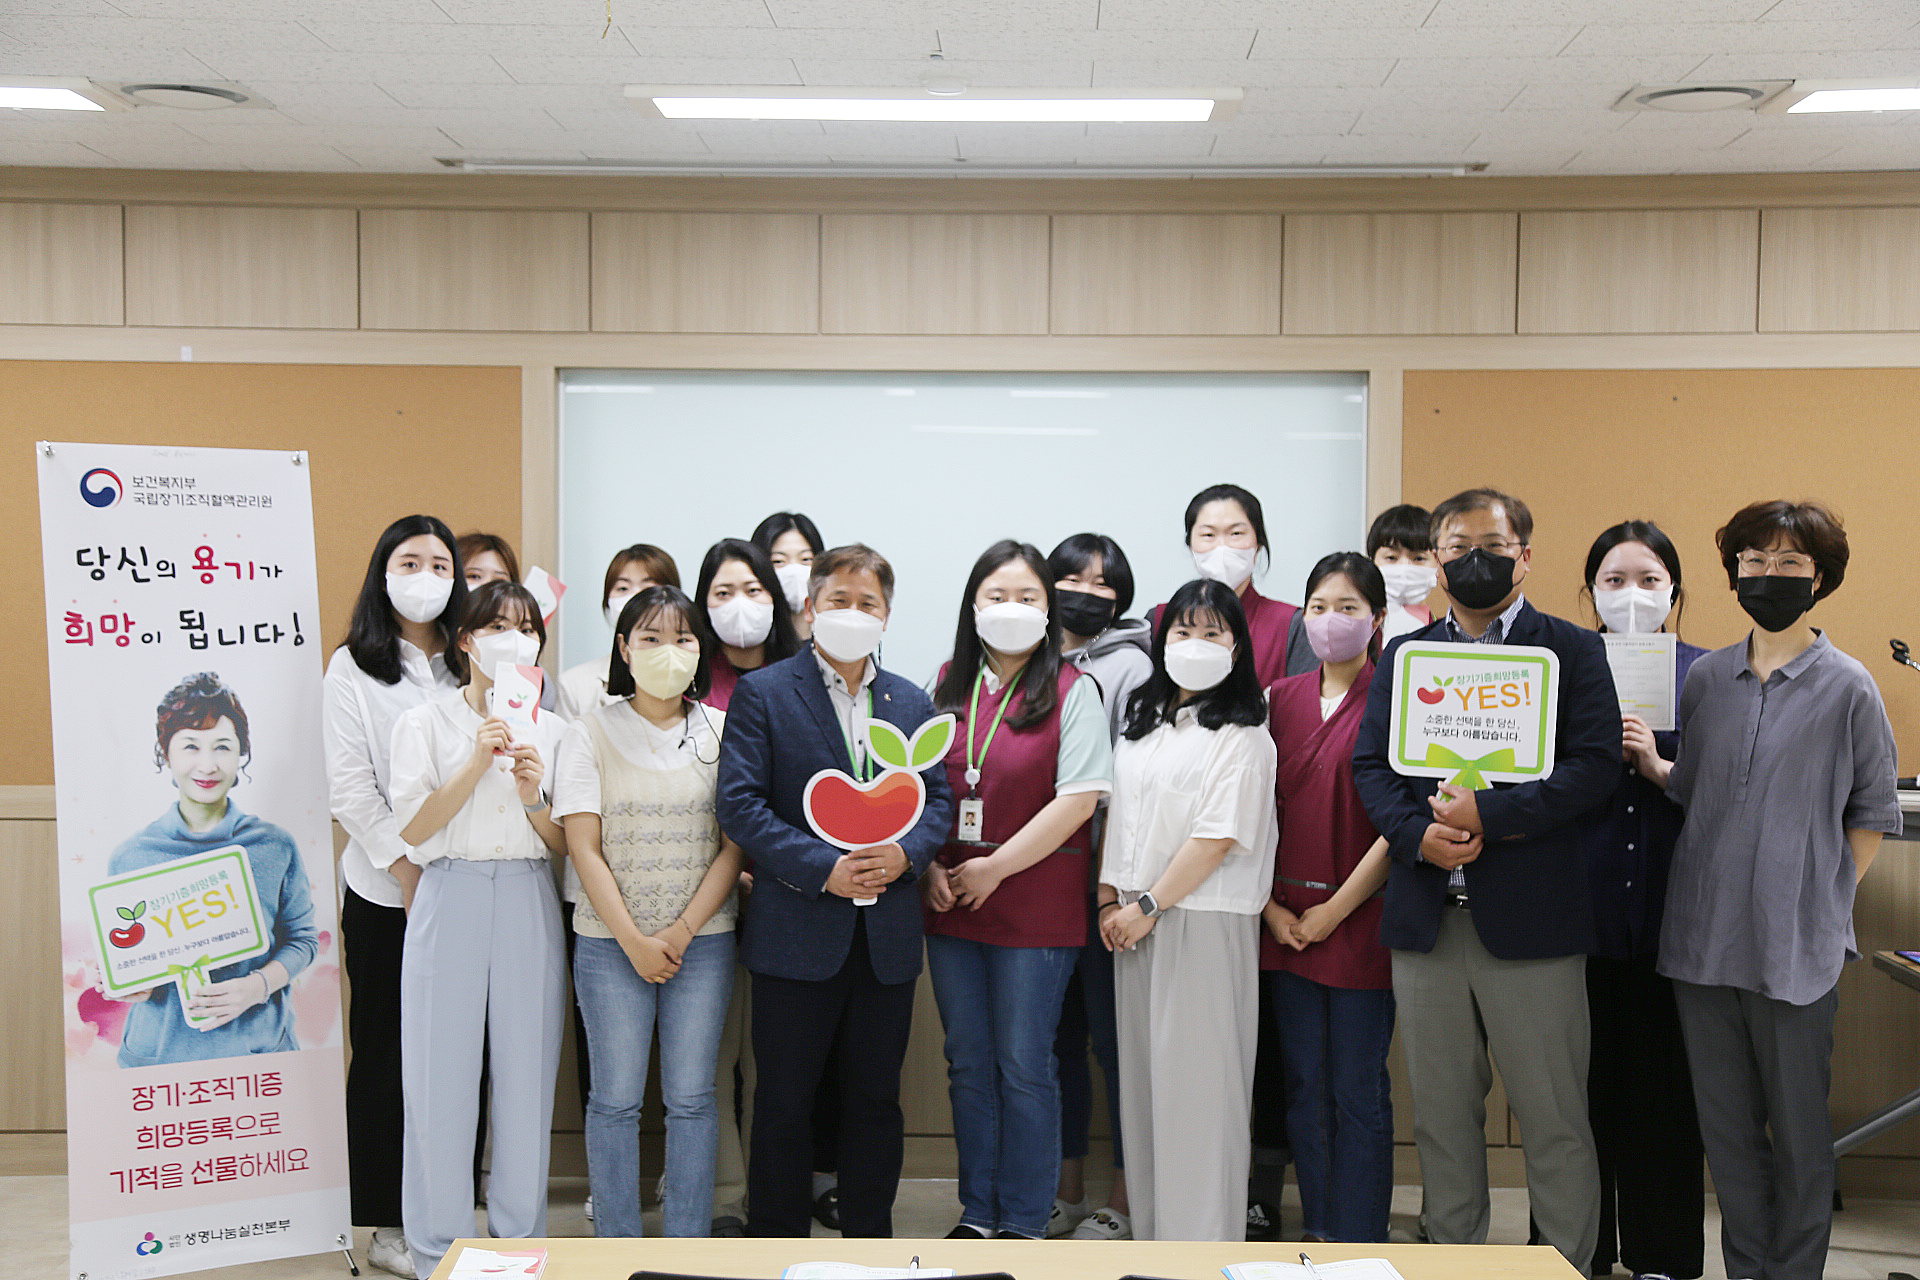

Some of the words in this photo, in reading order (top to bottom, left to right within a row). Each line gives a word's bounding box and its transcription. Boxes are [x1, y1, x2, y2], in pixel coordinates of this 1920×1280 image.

[132, 475, 197, 489] 보건복지부
[133, 491, 273, 508] 국립장기조직혈액관리원
[76, 546, 176, 583] 당신의
[192, 545, 283, 584] 용기가
[63, 611, 161, 647] 희망이
[179, 609, 305, 650] 됩니다!
[1453, 681, 1531, 711] YES!
[1422, 726, 1459, 738] 누구보다
[1425, 714, 1453, 725] 소중한
[1456, 716, 1482, 726] 선택을
[1485, 718, 1495, 728] 한
[150, 883, 239, 938] YES!
[132, 1072, 283, 1111] 장기·조직기증
[136, 1111, 282, 1150] 희망등록으로
[110, 1162, 184, 1194] 기적을
[191, 1148, 310, 1185] 선물하세요
[184, 1219, 291, 1246] 생명나눔실천본부
